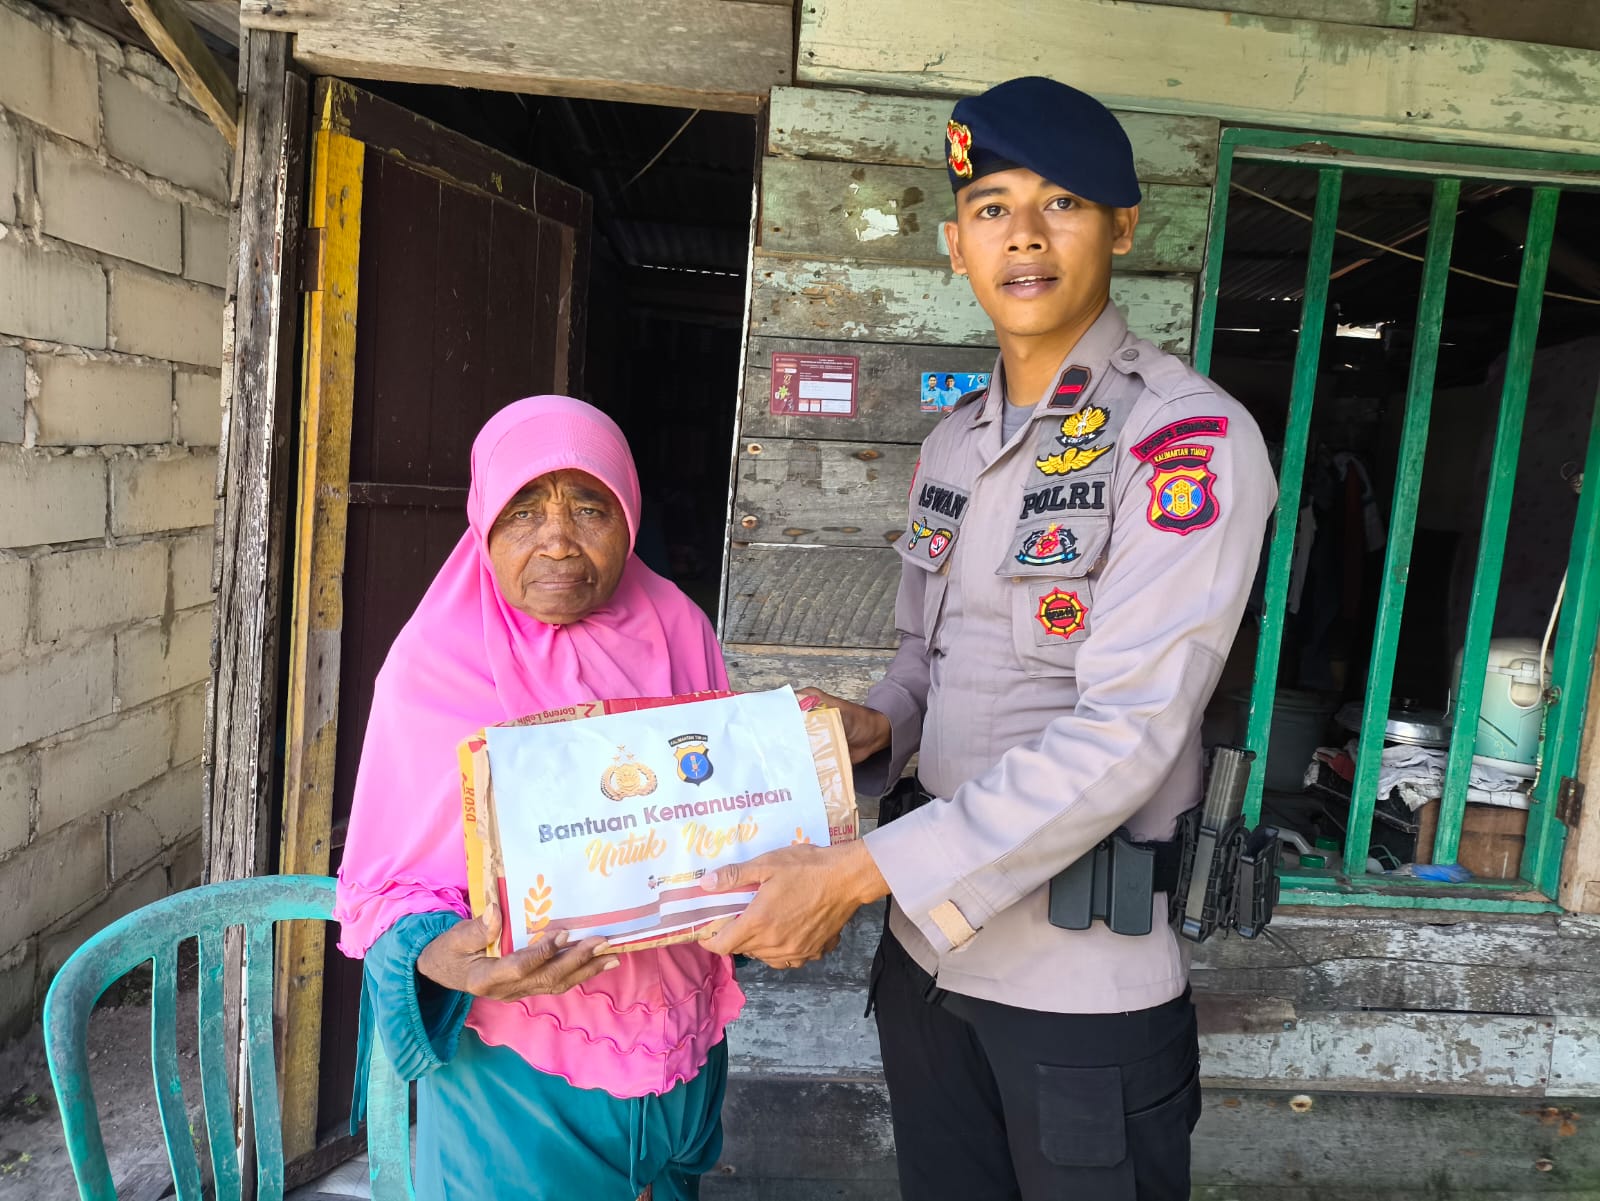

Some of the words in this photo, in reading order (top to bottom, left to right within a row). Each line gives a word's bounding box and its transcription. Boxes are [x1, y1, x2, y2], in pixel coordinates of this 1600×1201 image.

[967, 375, 976, 388] 7
[1153, 447, 1189, 463] KALIMANTAN
[918, 483, 968, 520] ASWAN
[1019, 481, 1106, 520] POLRI
[542, 707, 576, 719] Goreng
[538, 813, 638, 844] Bantuan
[643, 787, 793, 825] Kemanusiaan
[584, 828, 667, 878] Untuk
[681, 815, 759, 859] Negeri
